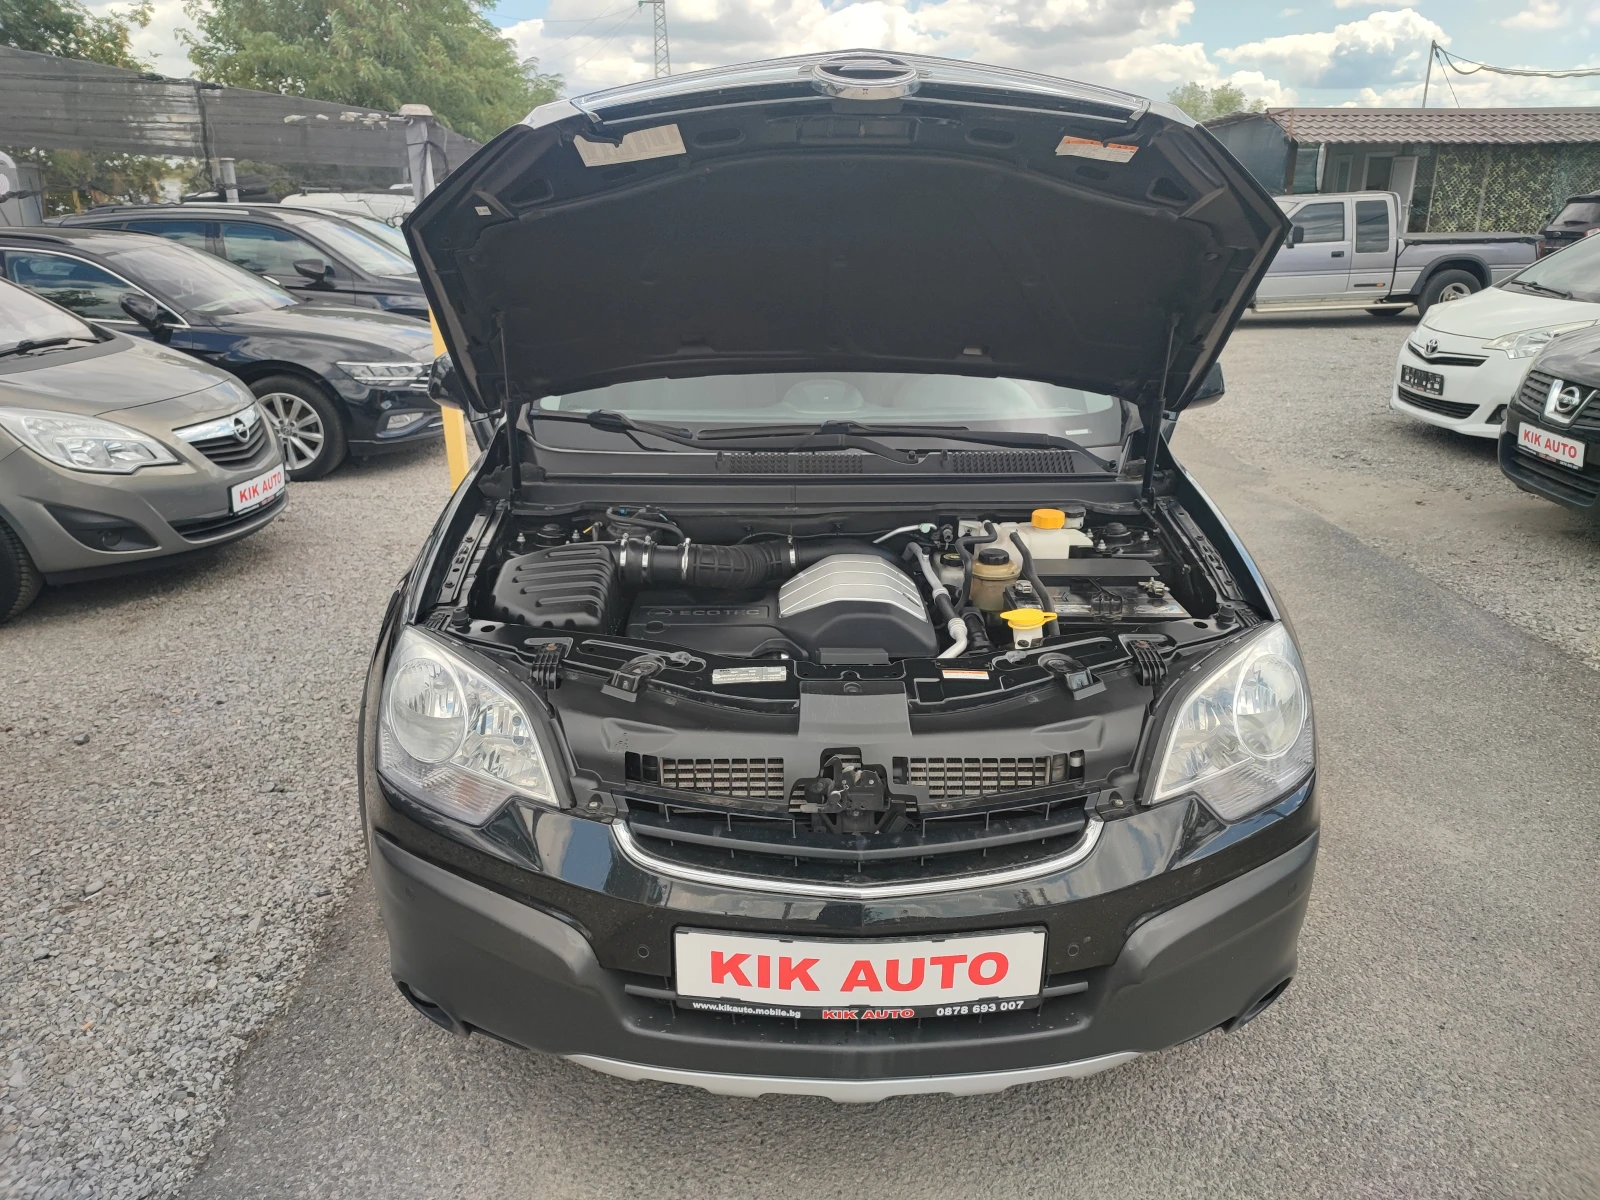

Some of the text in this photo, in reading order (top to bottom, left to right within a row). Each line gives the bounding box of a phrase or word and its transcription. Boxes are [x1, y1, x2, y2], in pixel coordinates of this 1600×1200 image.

[1523, 429, 1541, 447] KIK
[1544, 437, 1577, 459] AUTO
[239, 483, 259, 503] KIK
[262, 471, 282, 494] AUTO
[710, 951, 1009, 992] KIK AUTO
[692, 1002, 801, 1018] www.kikauto.mobile.bg
[822, 1008, 915, 1020] KIK AUTO
[936, 1000, 1025, 1016] 0878 693 007
